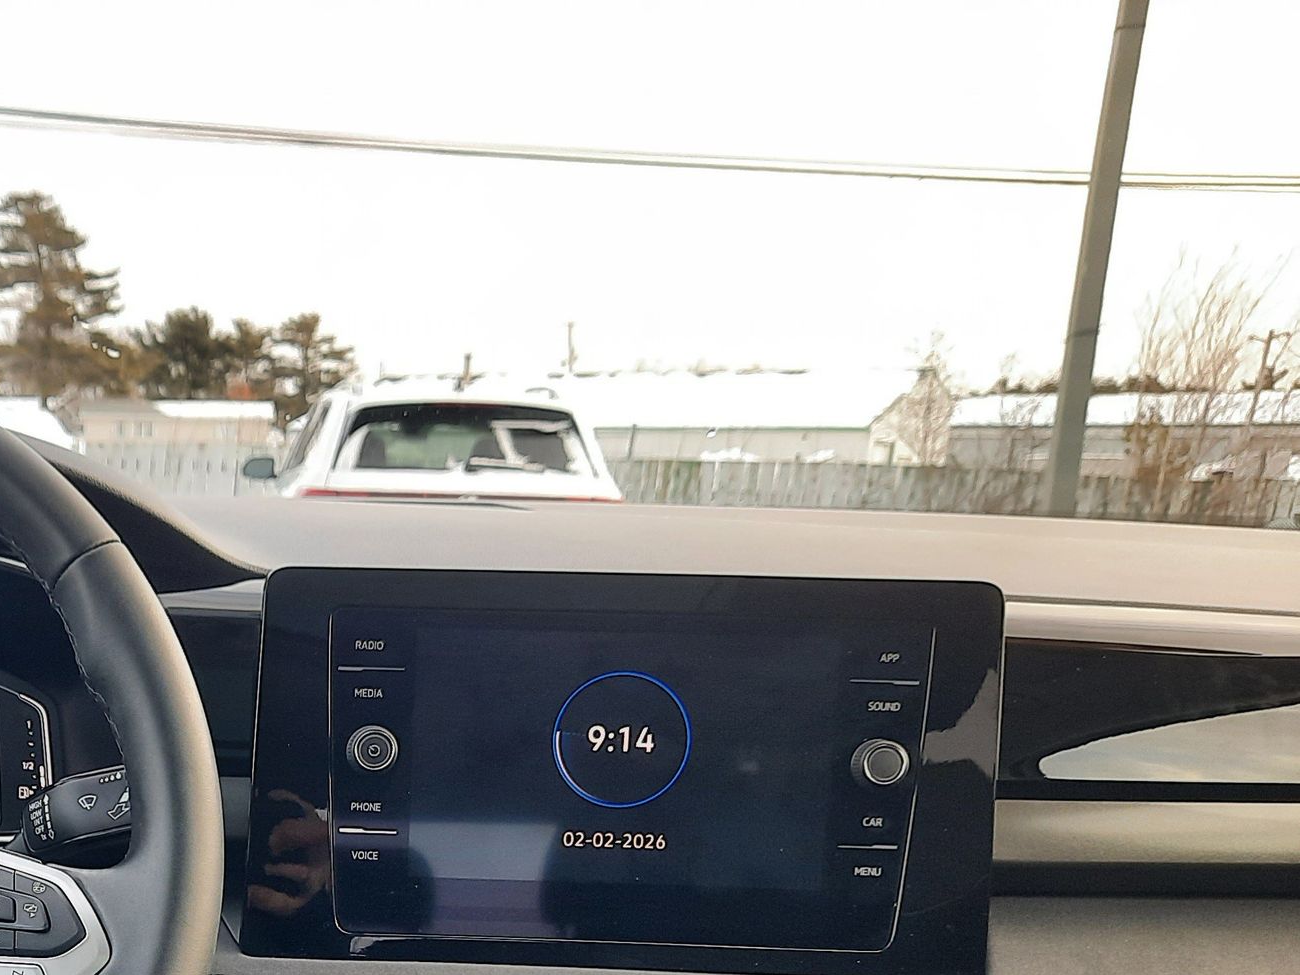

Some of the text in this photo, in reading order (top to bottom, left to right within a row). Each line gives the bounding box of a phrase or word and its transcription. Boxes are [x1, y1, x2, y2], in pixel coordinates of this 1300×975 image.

[355, 640, 384, 651] RADIO
[880, 653, 900, 664] APP
[354, 688, 383, 699] MEDIA
[867, 701, 901, 712] SOUND
[588, 725, 655, 753] 9:14
[350, 802, 382, 812] PHONE
[30, 809, 43, 820] LOW
[33, 816, 43, 827] INT
[862, 817, 883, 827] CAR
[35, 825, 45, 835] OFF
[563, 831, 666, 849] 02-02-2026
[351, 850, 379, 861] VOICE
[854, 867, 882, 877] MENU
